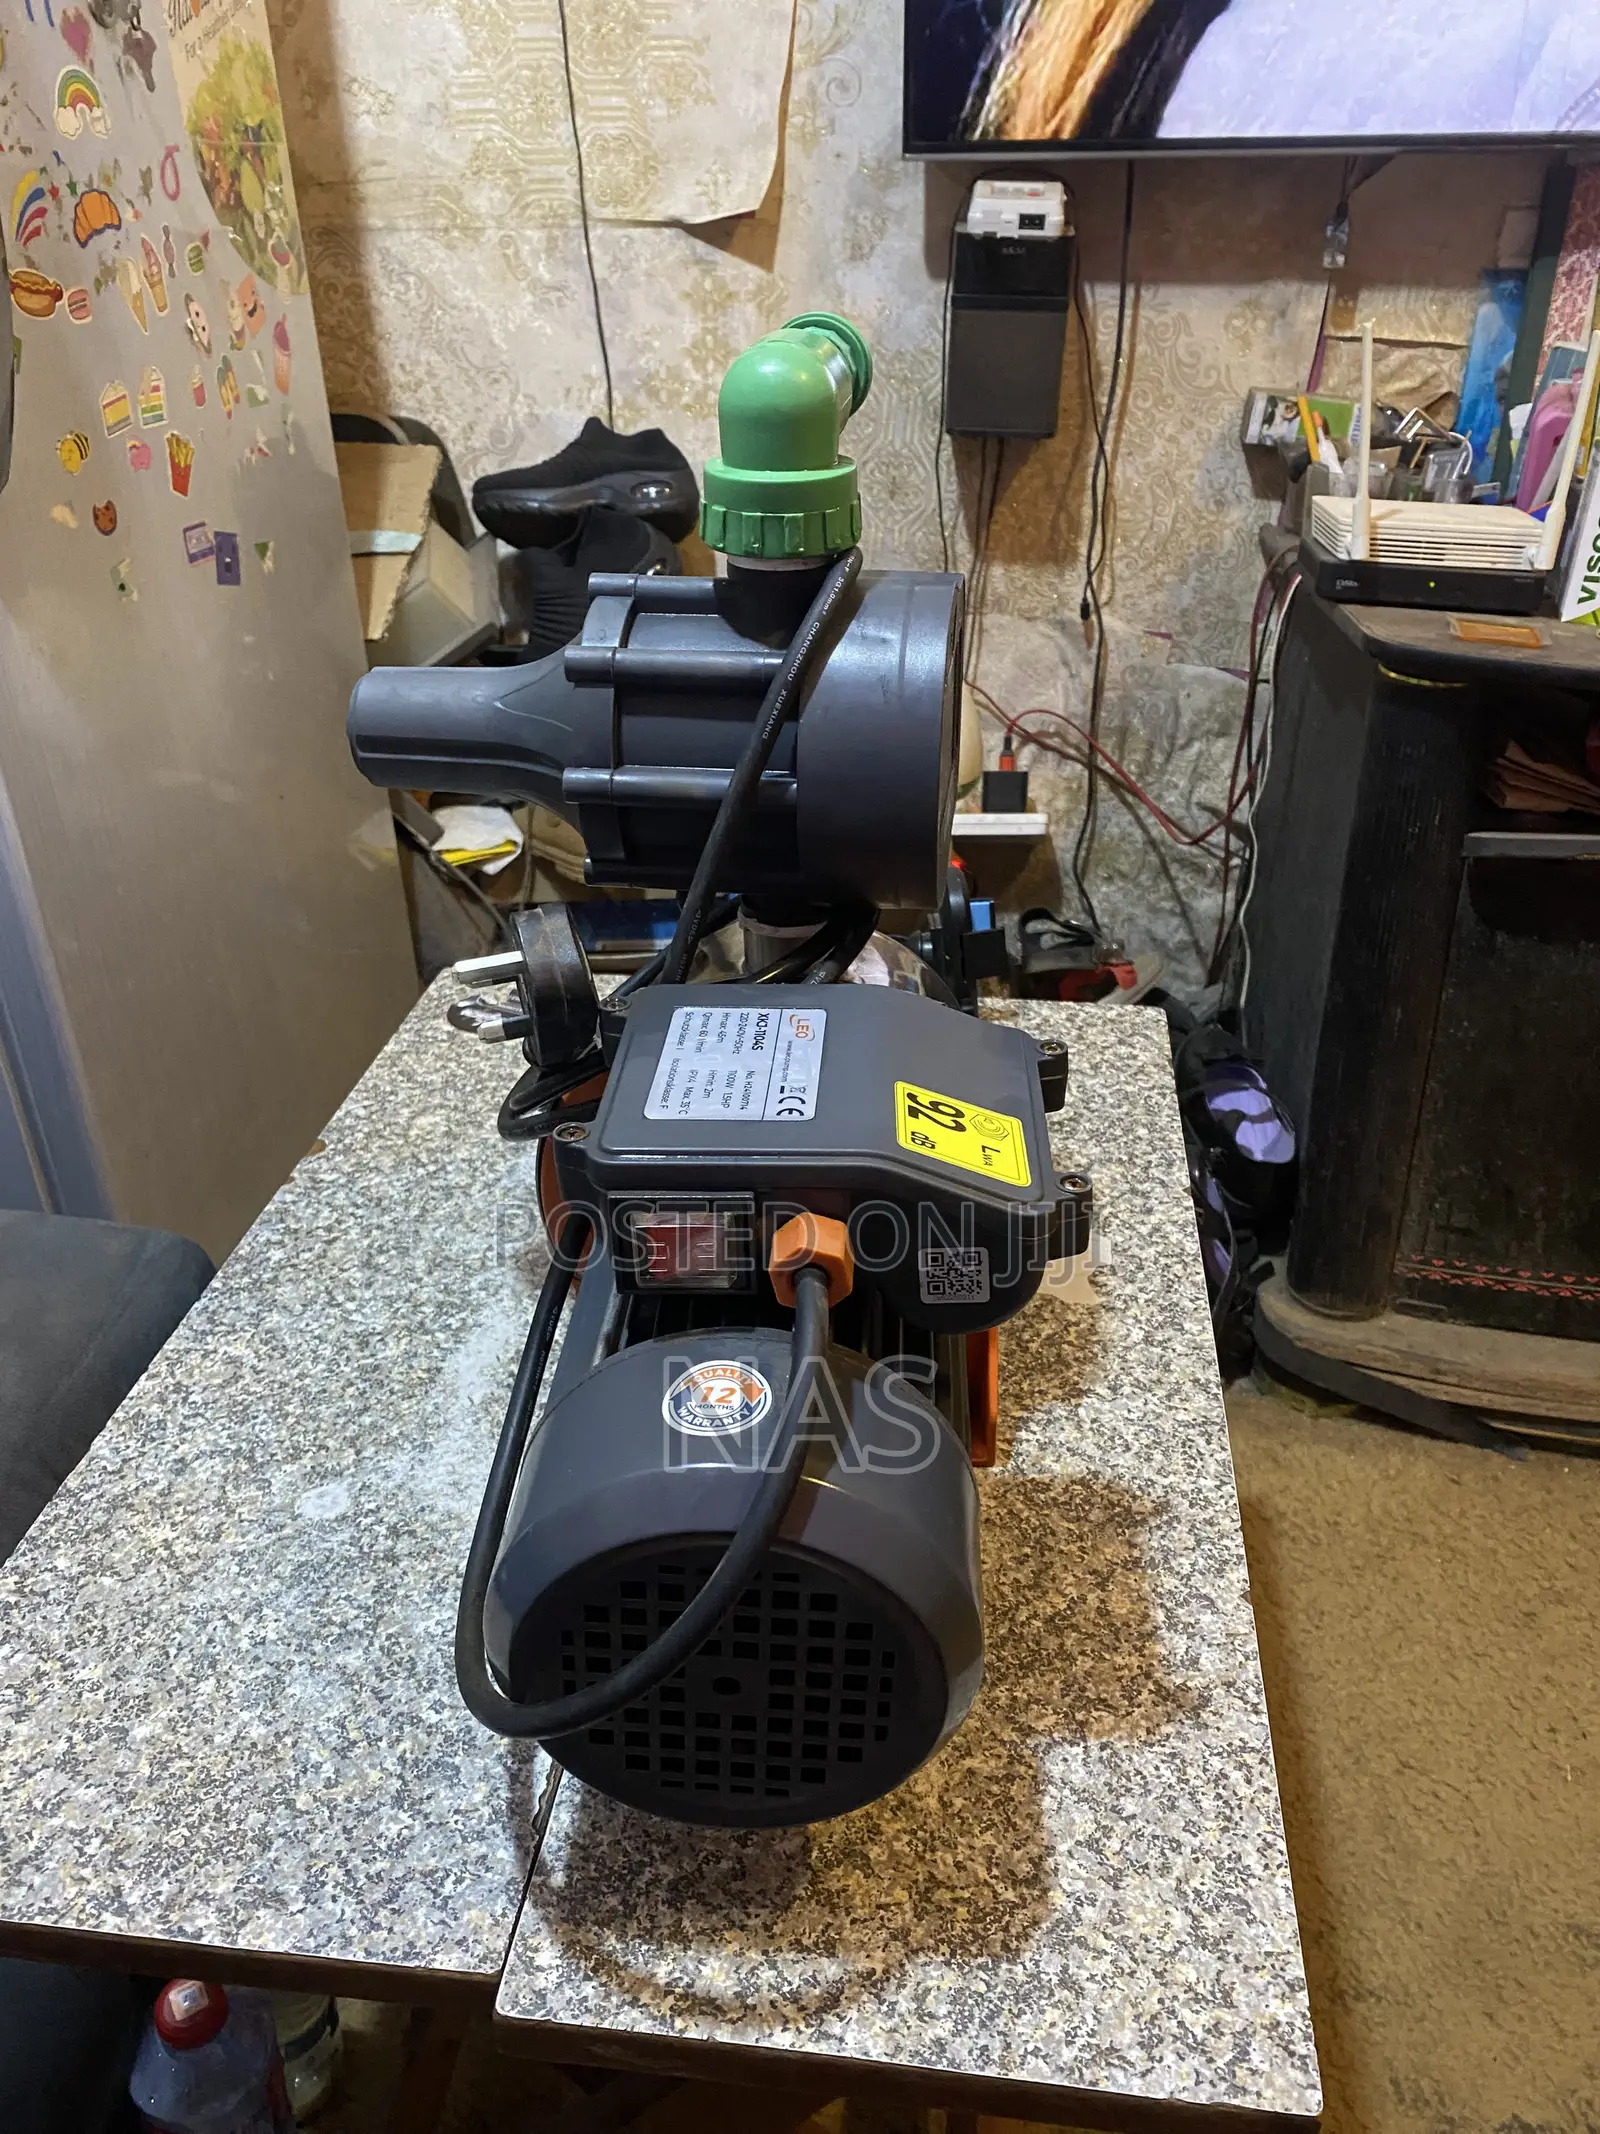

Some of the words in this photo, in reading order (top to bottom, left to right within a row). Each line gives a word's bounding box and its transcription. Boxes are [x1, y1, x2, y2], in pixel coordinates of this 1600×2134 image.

[787, 621, 820, 681] CHANGZHOU
[762, 689, 787, 740] XUEXIANG
[698, 1029, 706, 1037] 60
[716, 1031, 728, 1043] 45m
[752, 1012, 770, 1051] XKJ-1104S
[795, 1018, 810, 1039] LEO
[686, 1069, 698, 1083] IPX4
[725, 1070, 738, 1089] 1100W
[702, 1087, 711, 1099] 2m
[776, 1096, 806, 1116] CE
[906, 1091, 967, 1133] 92
[910, 1130, 937, 1150] dB
[693, 1368, 755, 1385] QUALITY
[700, 1386, 738, 1404] 12
[677, 1405, 752, 1427] WARRANTY
[694, 1403, 735, 1411] MONTHS
